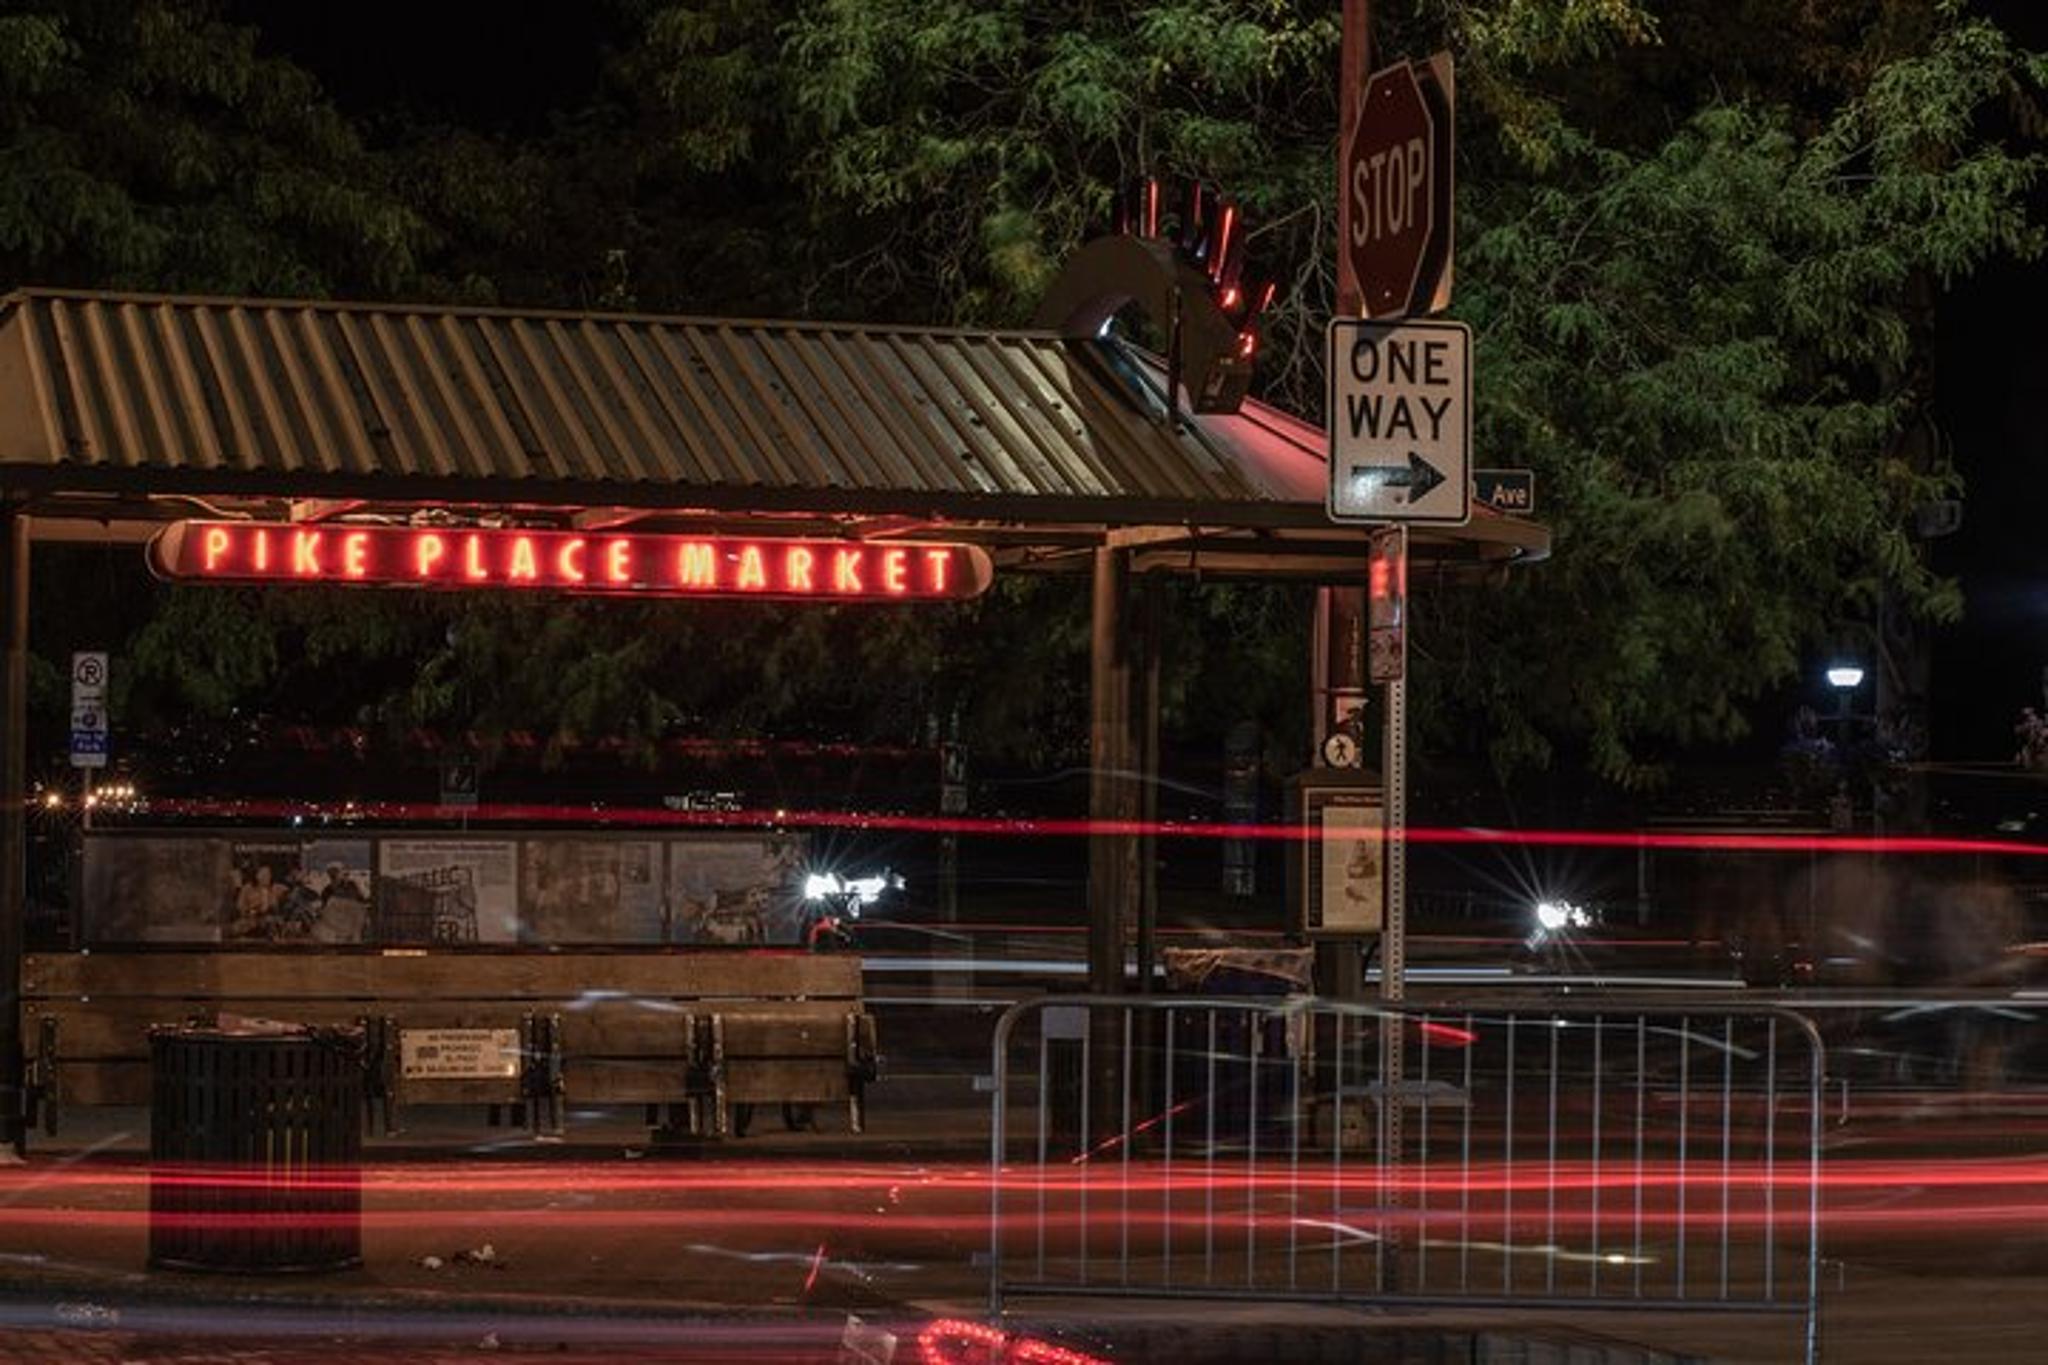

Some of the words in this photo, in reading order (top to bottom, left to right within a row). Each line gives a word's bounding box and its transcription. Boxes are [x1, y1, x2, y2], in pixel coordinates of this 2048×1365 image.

[1353, 138, 1425, 247] STOP
[1350, 338, 1449, 386] ONE
[1347, 394, 1452, 441] WAY
[1491, 483, 1526, 506] Ave
[205, 527, 369, 577] PIKE
[417, 534, 631, 582] PLACE
[679, 542, 950, 591] MARKET
